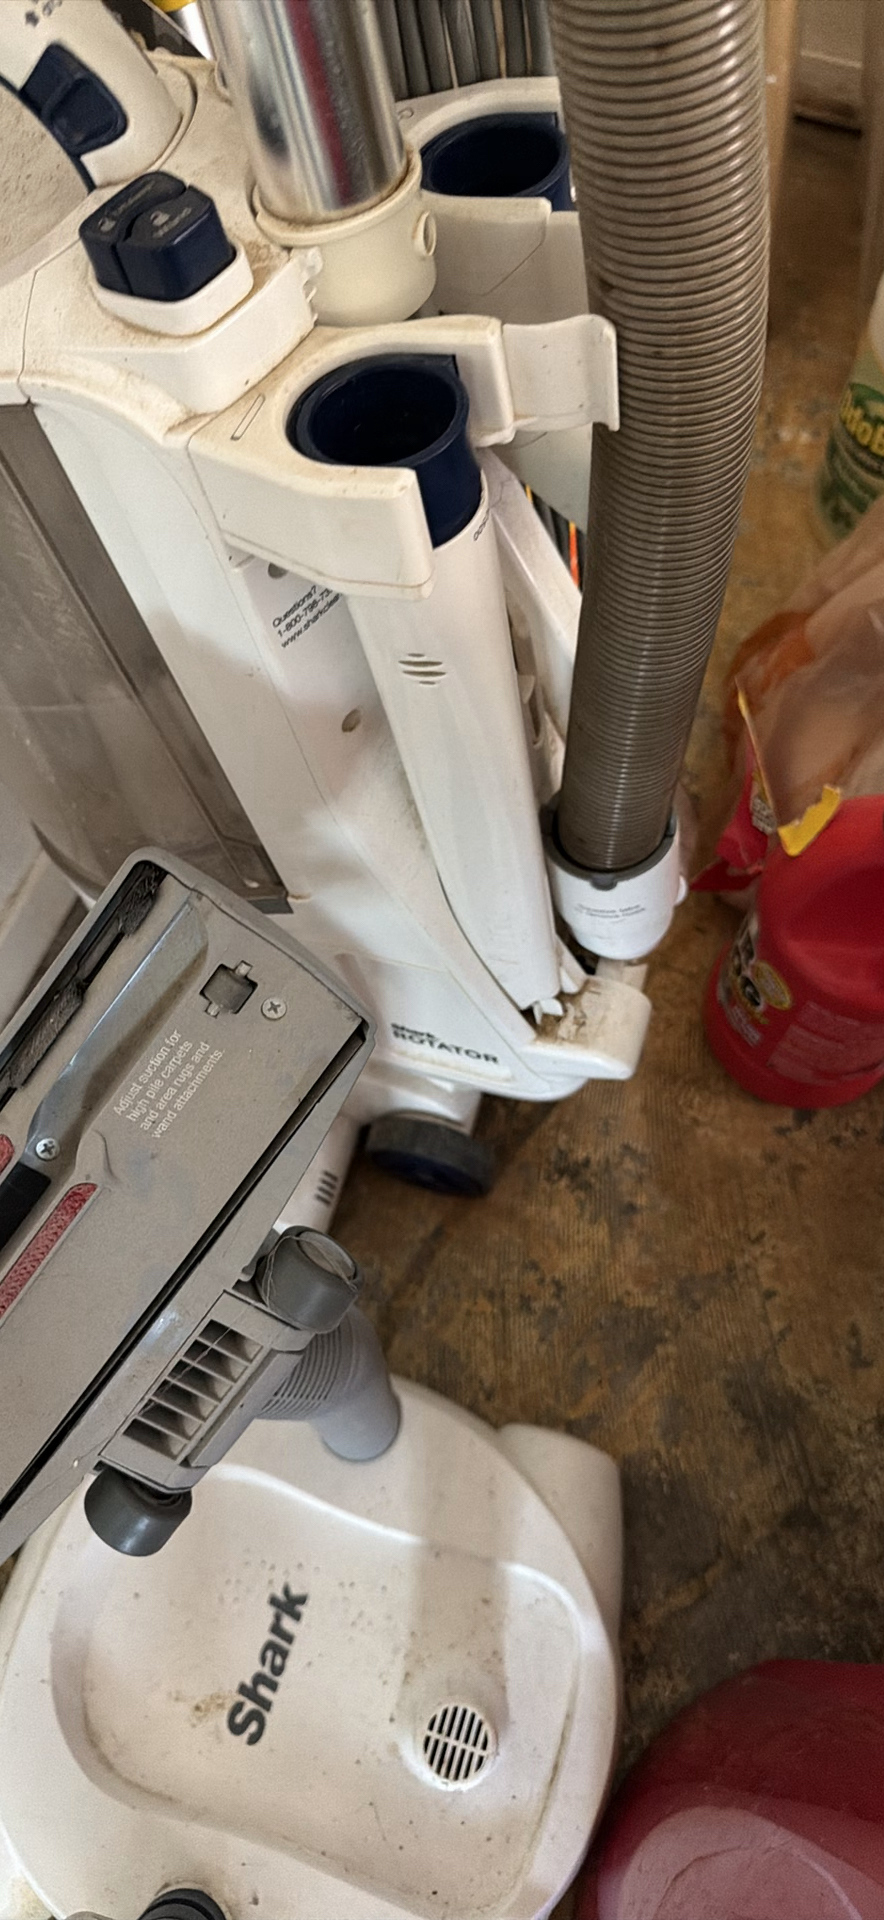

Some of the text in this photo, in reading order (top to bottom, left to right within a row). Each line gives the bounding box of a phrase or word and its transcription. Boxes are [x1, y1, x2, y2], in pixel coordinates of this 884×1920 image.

[272, 585, 316, 628] Questions?
[113, 1029, 181, 1115] Adjust suction for
[126, 1041, 192, 1122] high pile carpets
[140, 1041, 210, 1130] and area rugs and
[393, 1030, 499, 1064] ROTATOR
[152, 1049, 225, 1138] wand attachments.
[227, 1582, 308, 1746] Shark
